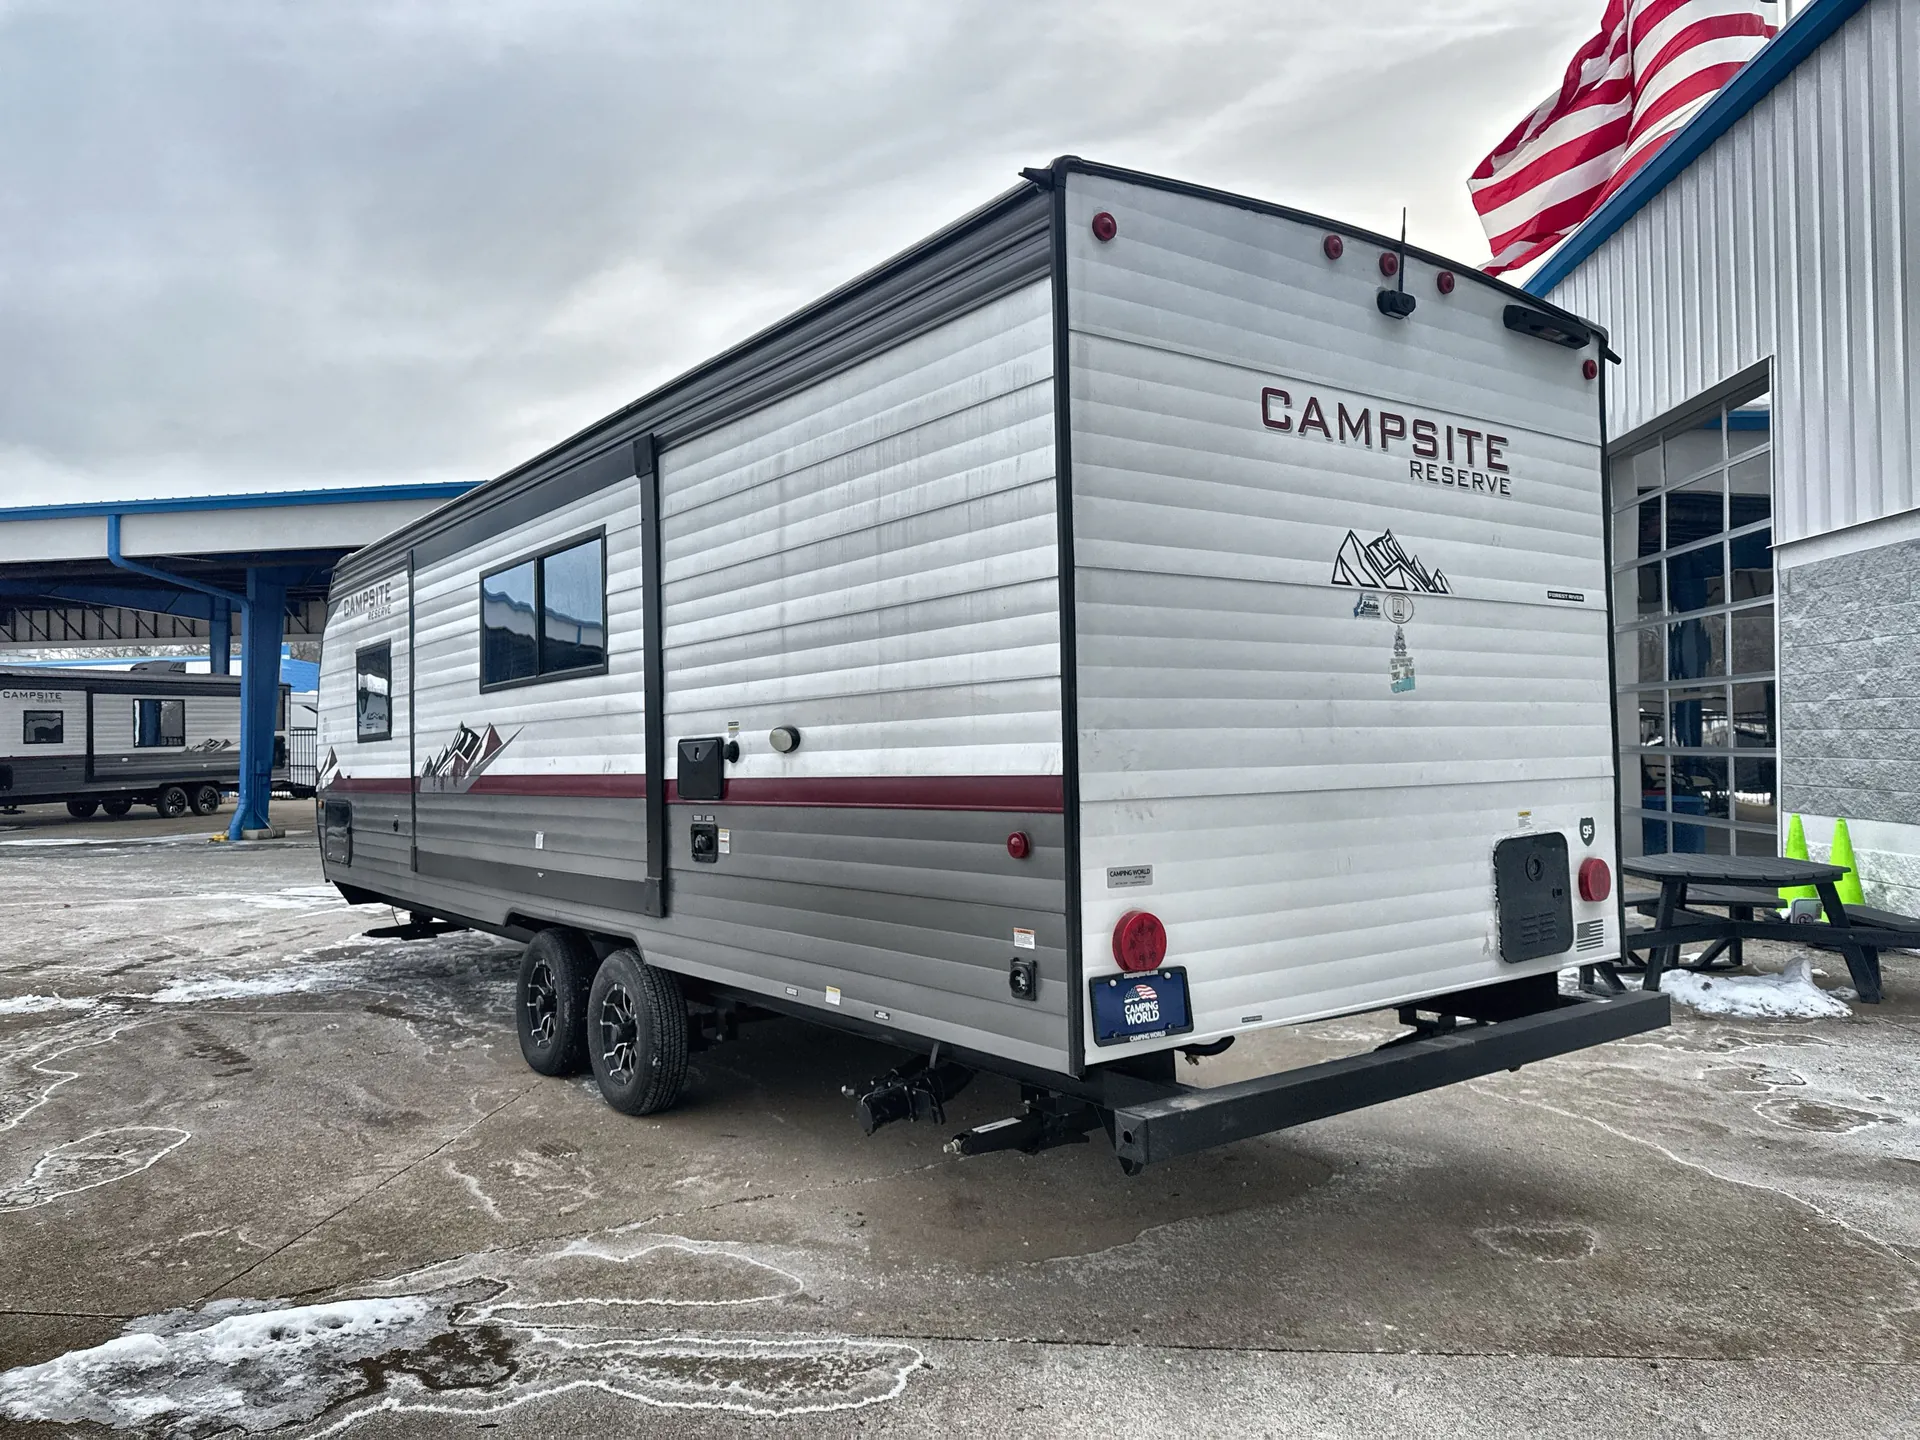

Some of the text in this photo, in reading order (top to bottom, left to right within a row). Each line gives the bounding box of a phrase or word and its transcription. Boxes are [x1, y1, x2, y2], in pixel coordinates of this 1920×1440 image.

[1261, 386, 1509, 472] CAMPSITE
[1409, 459, 1511, 496] RESERVE
[343, 582, 391, 617] CAMPSITE
[367, 604, 392, 621] RESERVE
[3, 691, 62, 700] CAMPSITE
[1582, 824, 1593, 839] gs
[1109, 869, 1132, 877] CAMPING
[1124, 1001, 1158, 1014] CAMPING
[1125, 1010, 1160, 1025] WORLD
[1129, 1030, 1166, 1042] CAMPING WORLD
